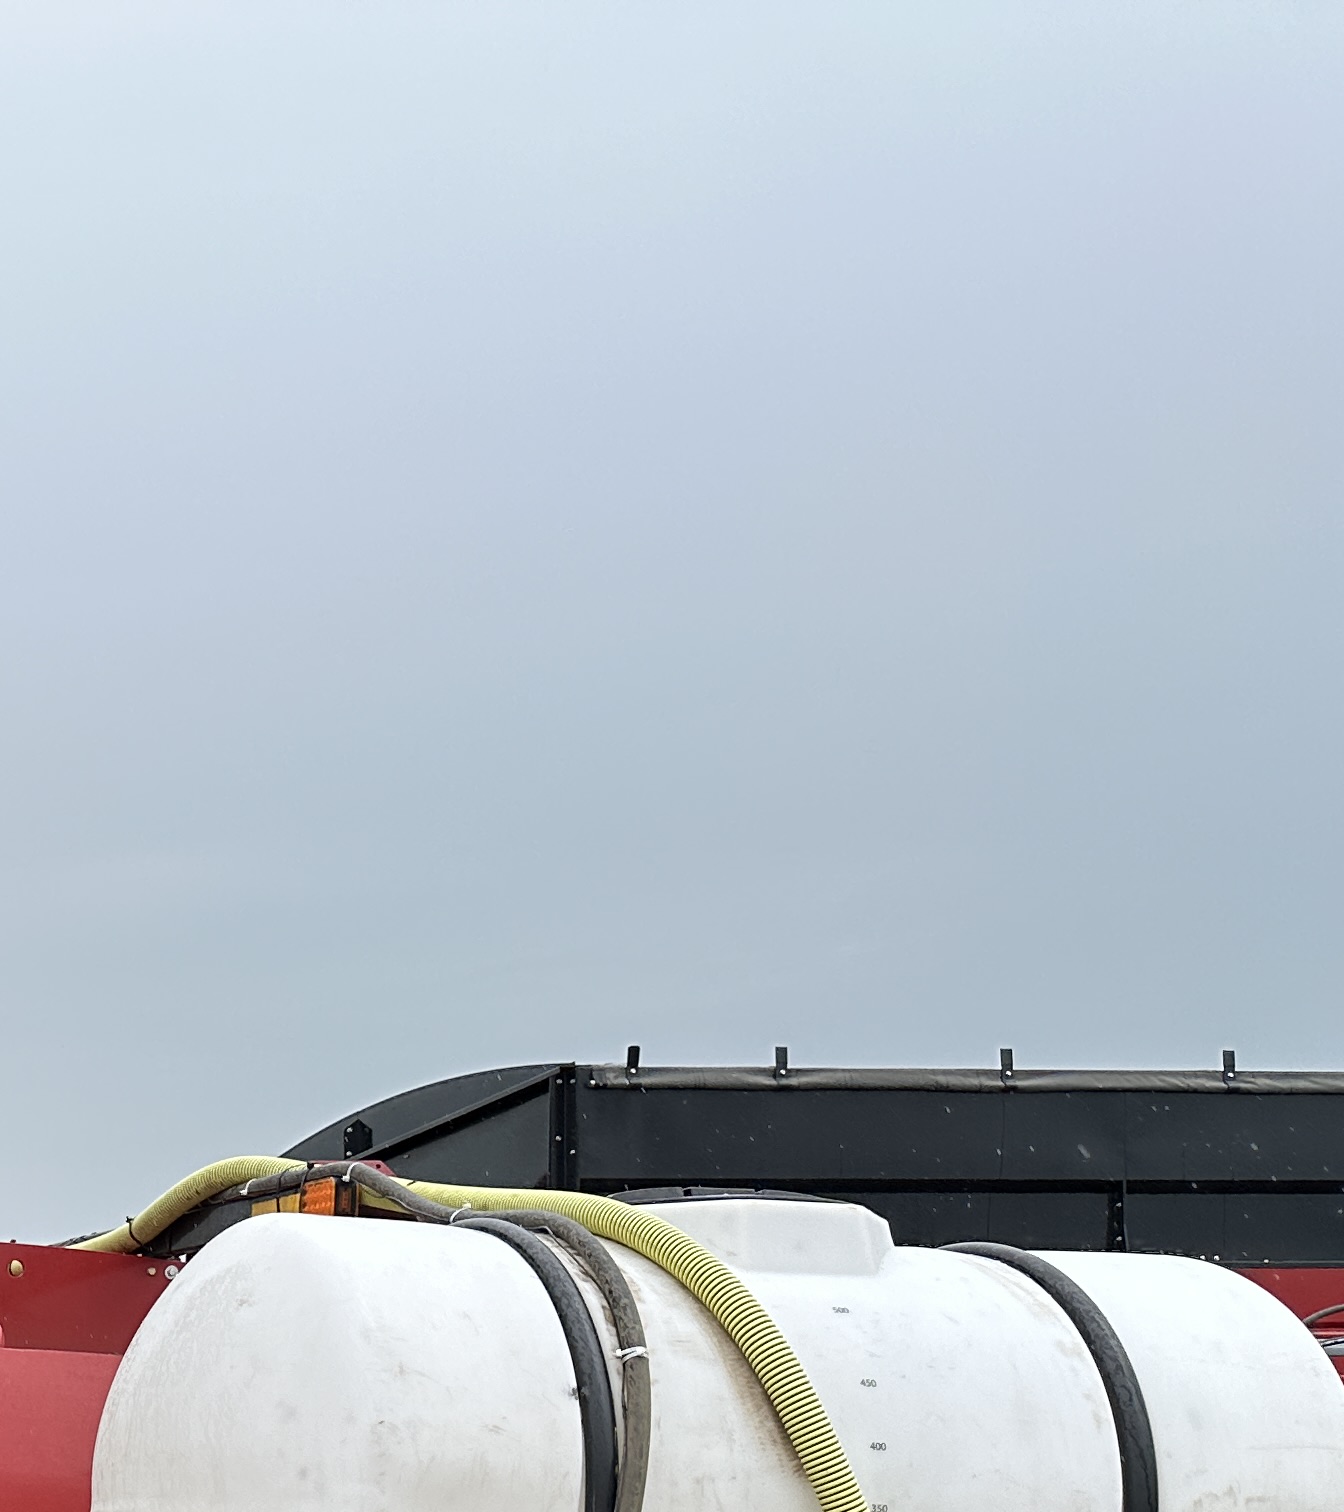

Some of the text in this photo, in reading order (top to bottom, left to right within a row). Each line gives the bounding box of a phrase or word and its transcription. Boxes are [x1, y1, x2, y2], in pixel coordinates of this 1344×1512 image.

[859, 1379, 877, 1388] 450
[870, 1442, 887, 1451] 400
[871, 1504, 888, 1512] 350
